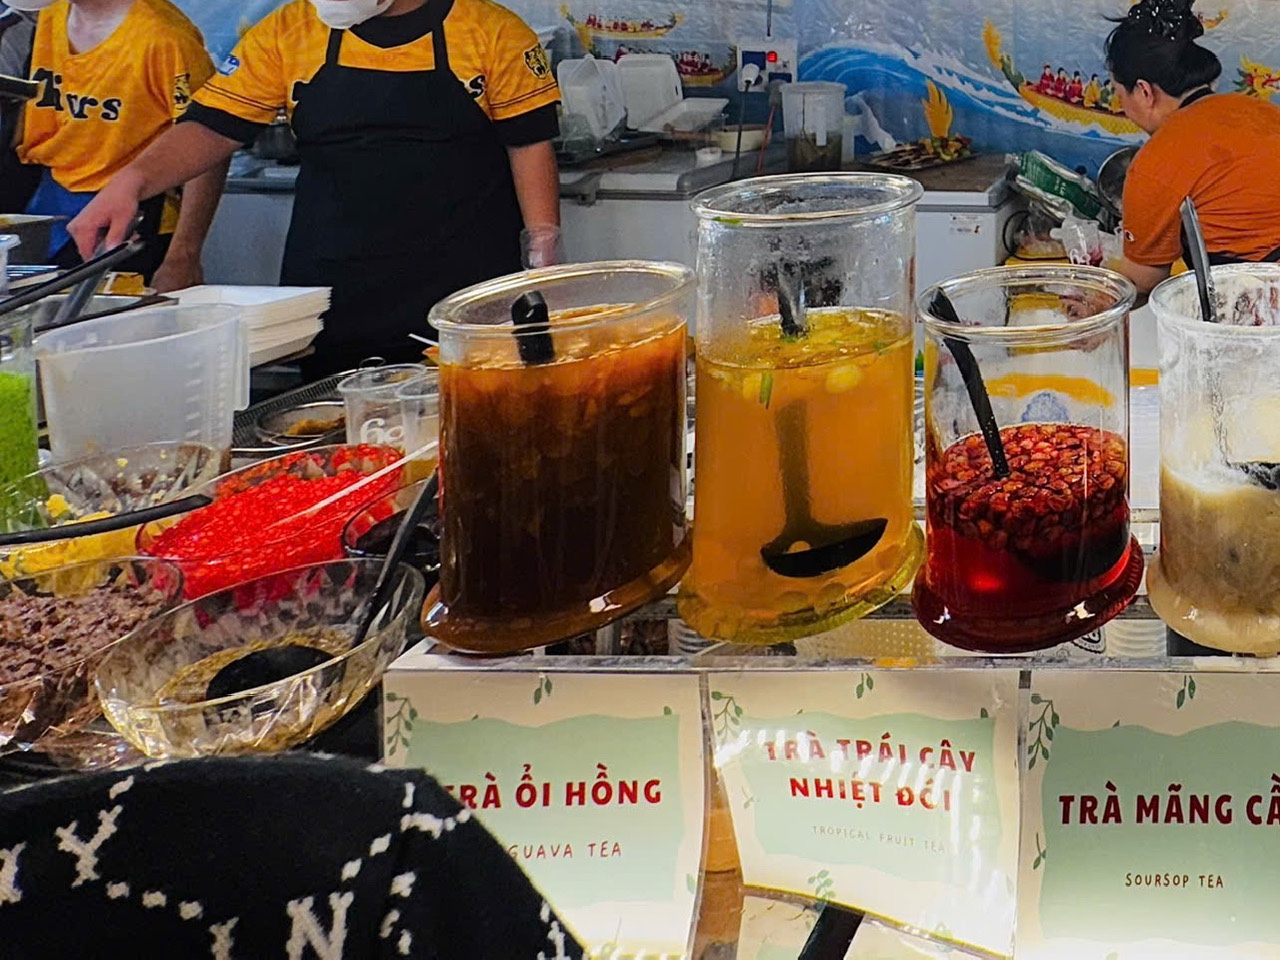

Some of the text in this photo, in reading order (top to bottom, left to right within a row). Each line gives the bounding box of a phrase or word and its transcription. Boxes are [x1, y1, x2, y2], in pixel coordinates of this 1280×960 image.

[763, 730, 976, 773] TRÀ TRÁI CÂY
[444, 762, 662, 809] RÀ ỔI HỒNG
[788, 772, 883, 809] NHIỆT
[1058, 780, 1122, 825] TRÀ
[1135, 783, 1233, 825] MÃNG
[588, 840, 622, 858] TEA
[812, 825, 871, 841] TROPICAL
[1124, 872, 1224, 889] SOURSOP TEA
